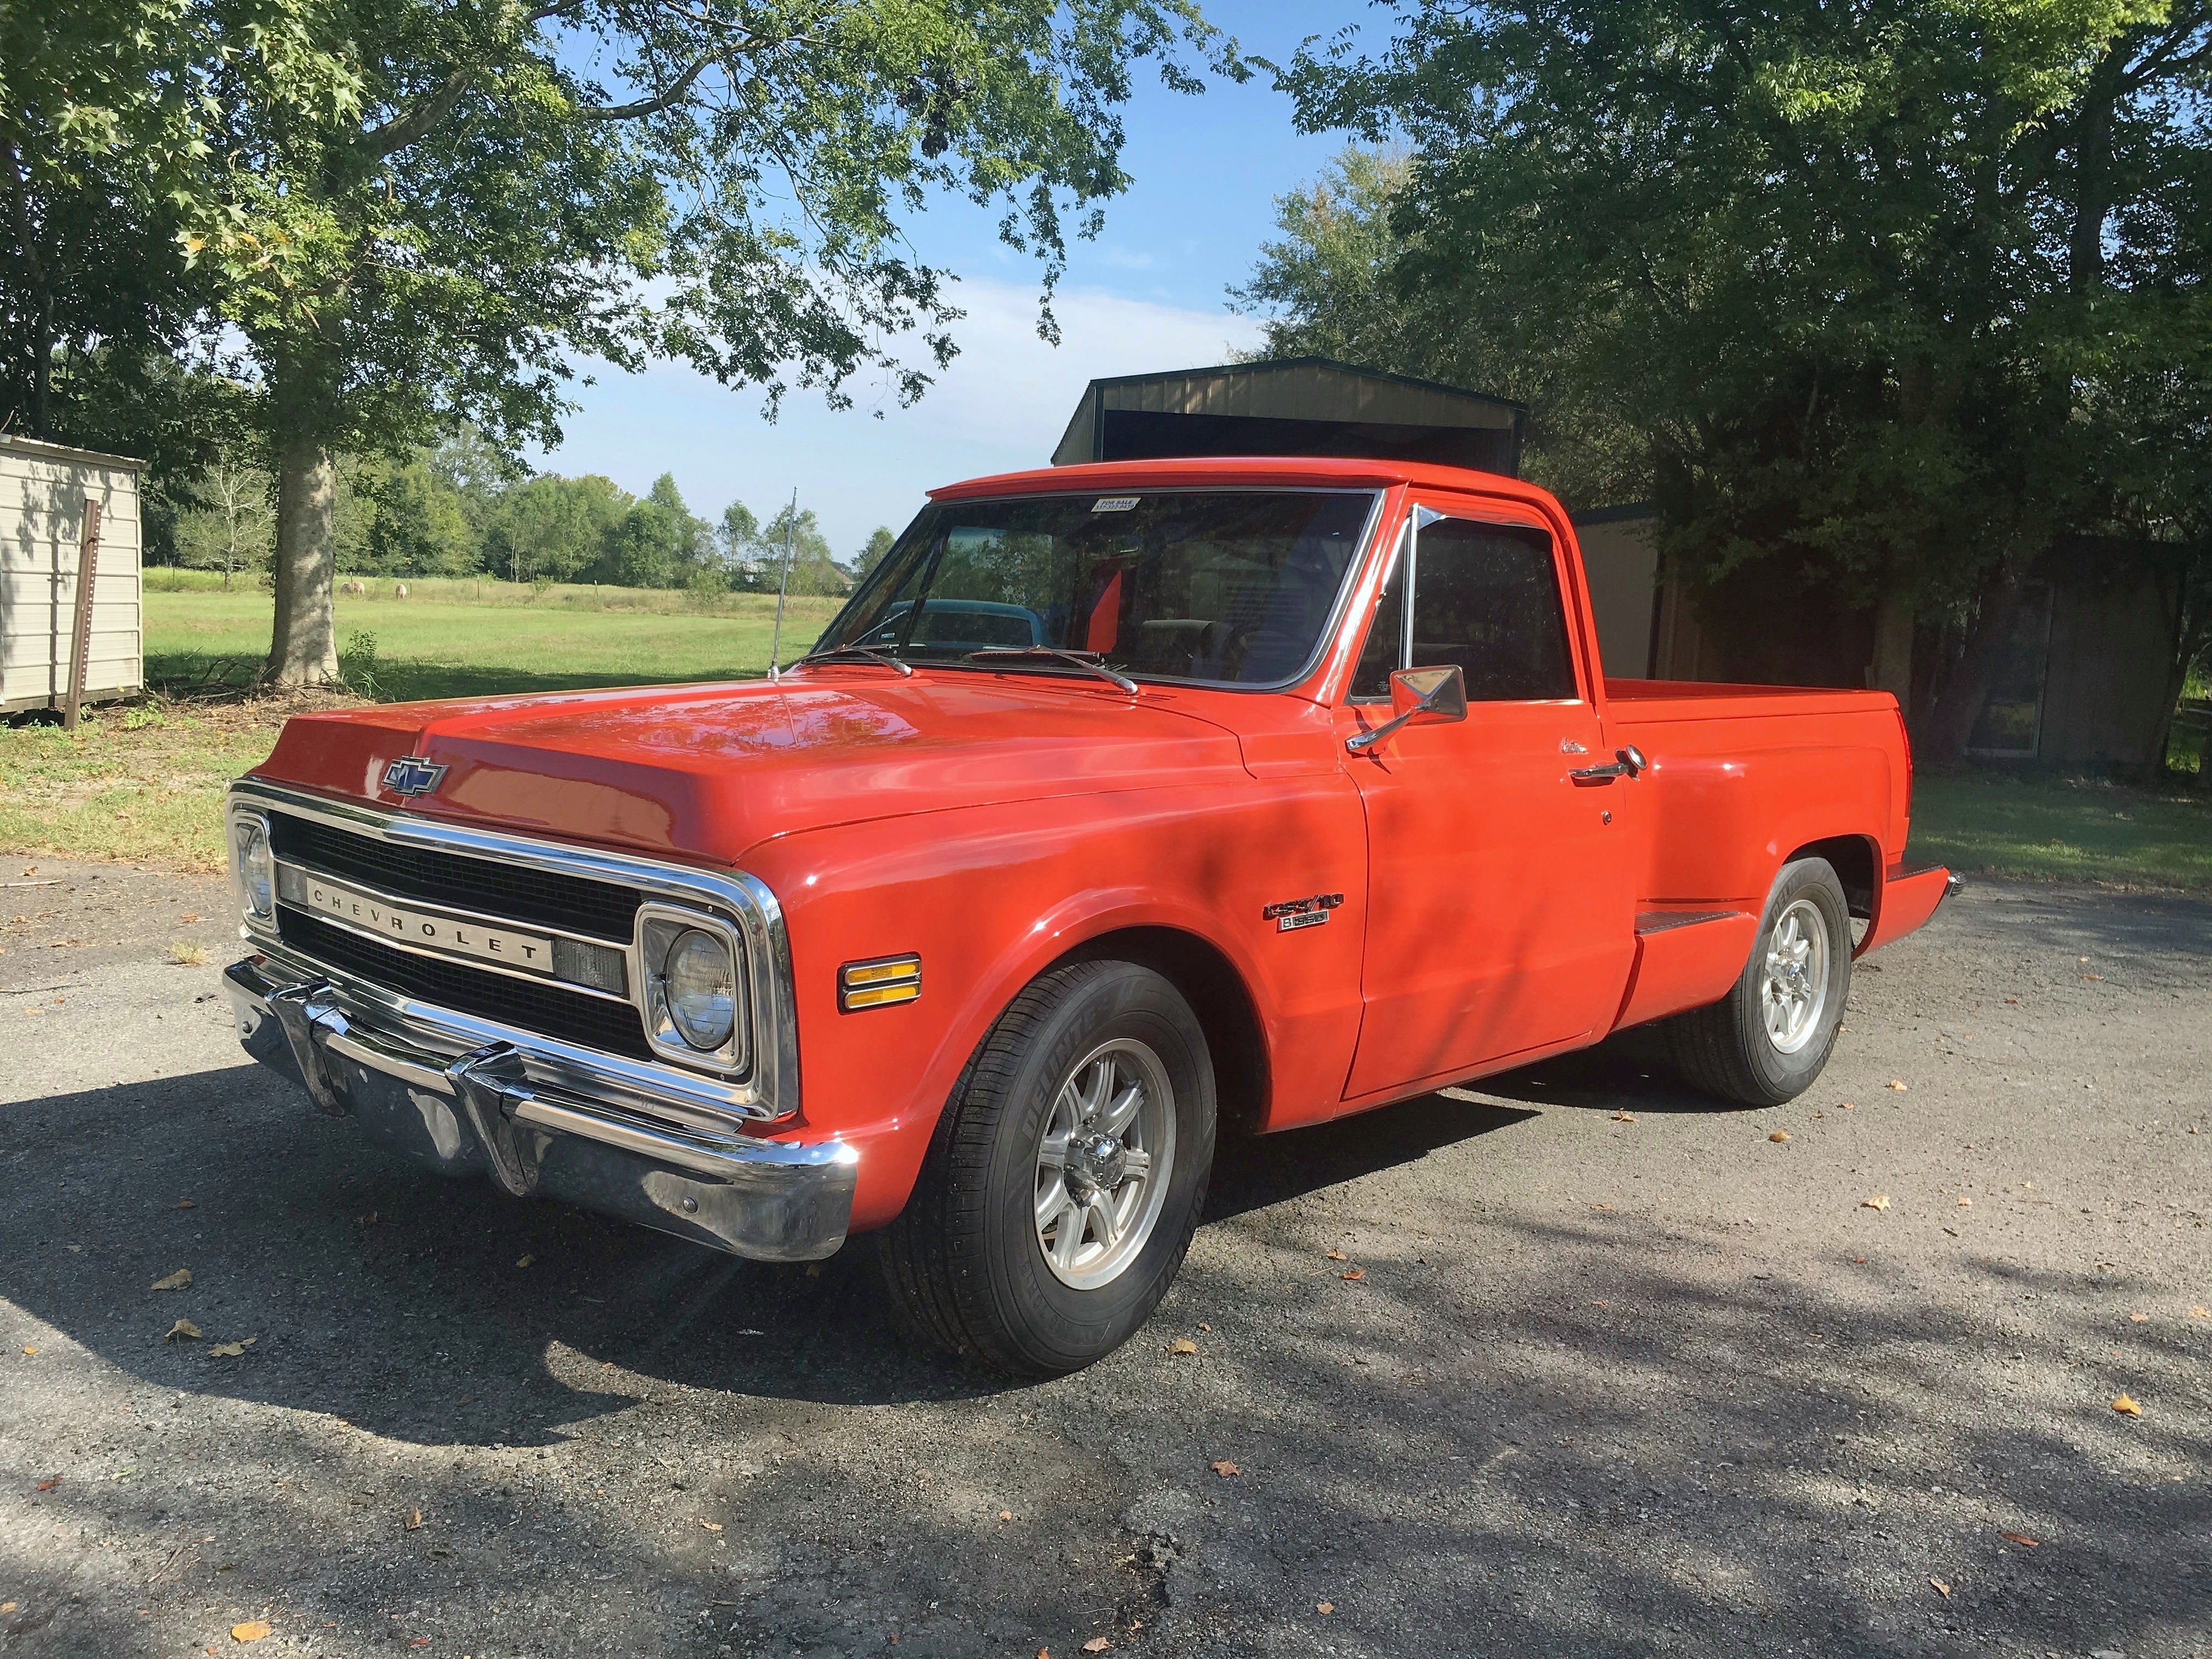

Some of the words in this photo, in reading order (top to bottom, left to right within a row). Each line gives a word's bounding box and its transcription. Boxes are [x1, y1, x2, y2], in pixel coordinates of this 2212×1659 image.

[314, 890, 537, 958] CHEVROLET
[1294, 912, 1325, 926] 350
[1021, 1011, 1098, 1141] DELINTE
